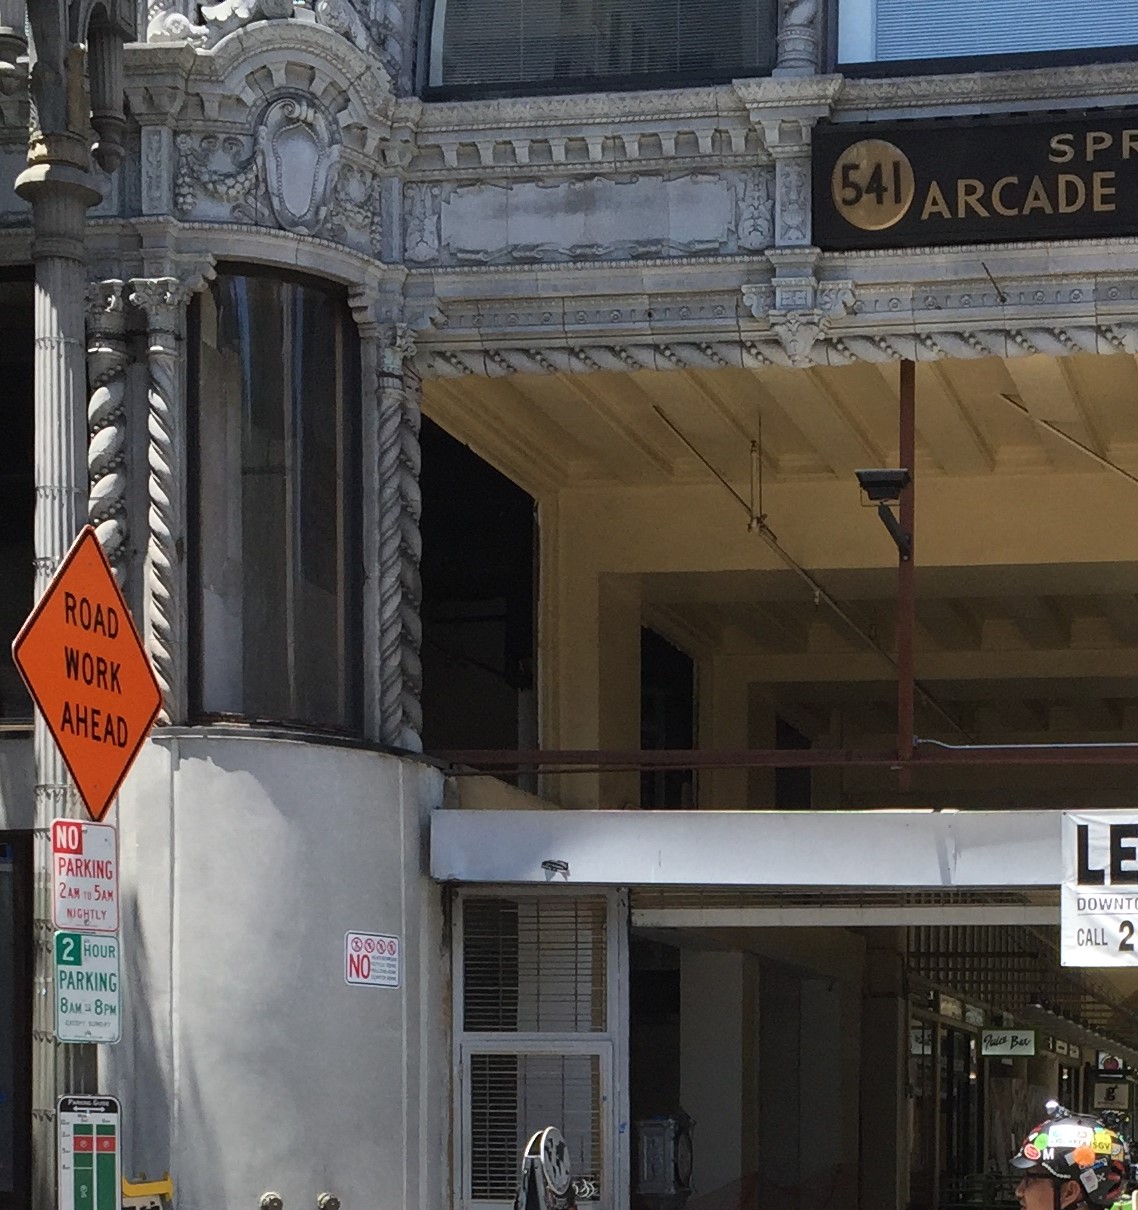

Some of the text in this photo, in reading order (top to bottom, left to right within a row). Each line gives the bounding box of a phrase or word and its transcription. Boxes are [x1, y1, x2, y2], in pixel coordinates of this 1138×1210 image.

[841, 161, 902, 206] 541
[921, 170, 1116, 220] ARCADE
[64, 592, 118, 639] ROAD
[64, 645, 121, 694] WORK
[60, 701, 128, 748] AHEAD
[56, 825, 79, 850] NO
[58, 857, 113, 880] PARKING
[59, 882, 80, 899] 2AM
[94, 885, 114, 901] 5AM
[66, 908, 107, 921] NIGHTLY
[62, 937, 116, 961] 2 HOUR
[1077, 928, 1108, 947] CALL
[349, 953, 370, 979] NO
[59, 970, 117, 993] PARKING
[60, 998, 81, 1014] 8AM
[94, 999, 117, 1016] 8PM
[1043, 1148, 1054, 1160] M
